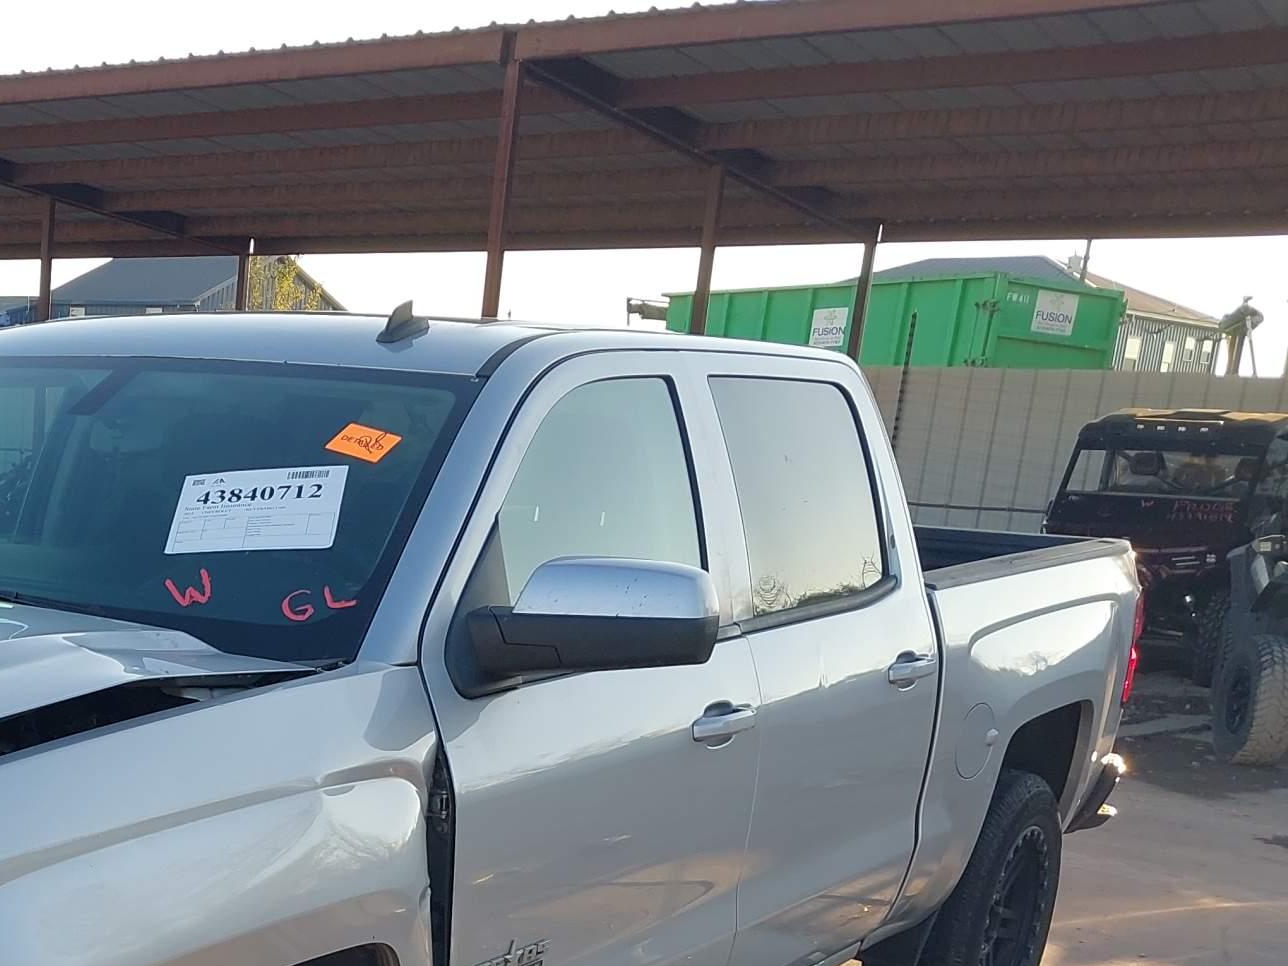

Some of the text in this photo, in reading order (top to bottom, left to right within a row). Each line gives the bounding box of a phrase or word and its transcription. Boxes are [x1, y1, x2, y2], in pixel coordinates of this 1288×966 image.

[1035, 310, 1073, 325] FUSION
[812, 326, 846, 337] FUSION
[196, 483, 324, 505] 43840712
[164, 568, 212, 607] W
